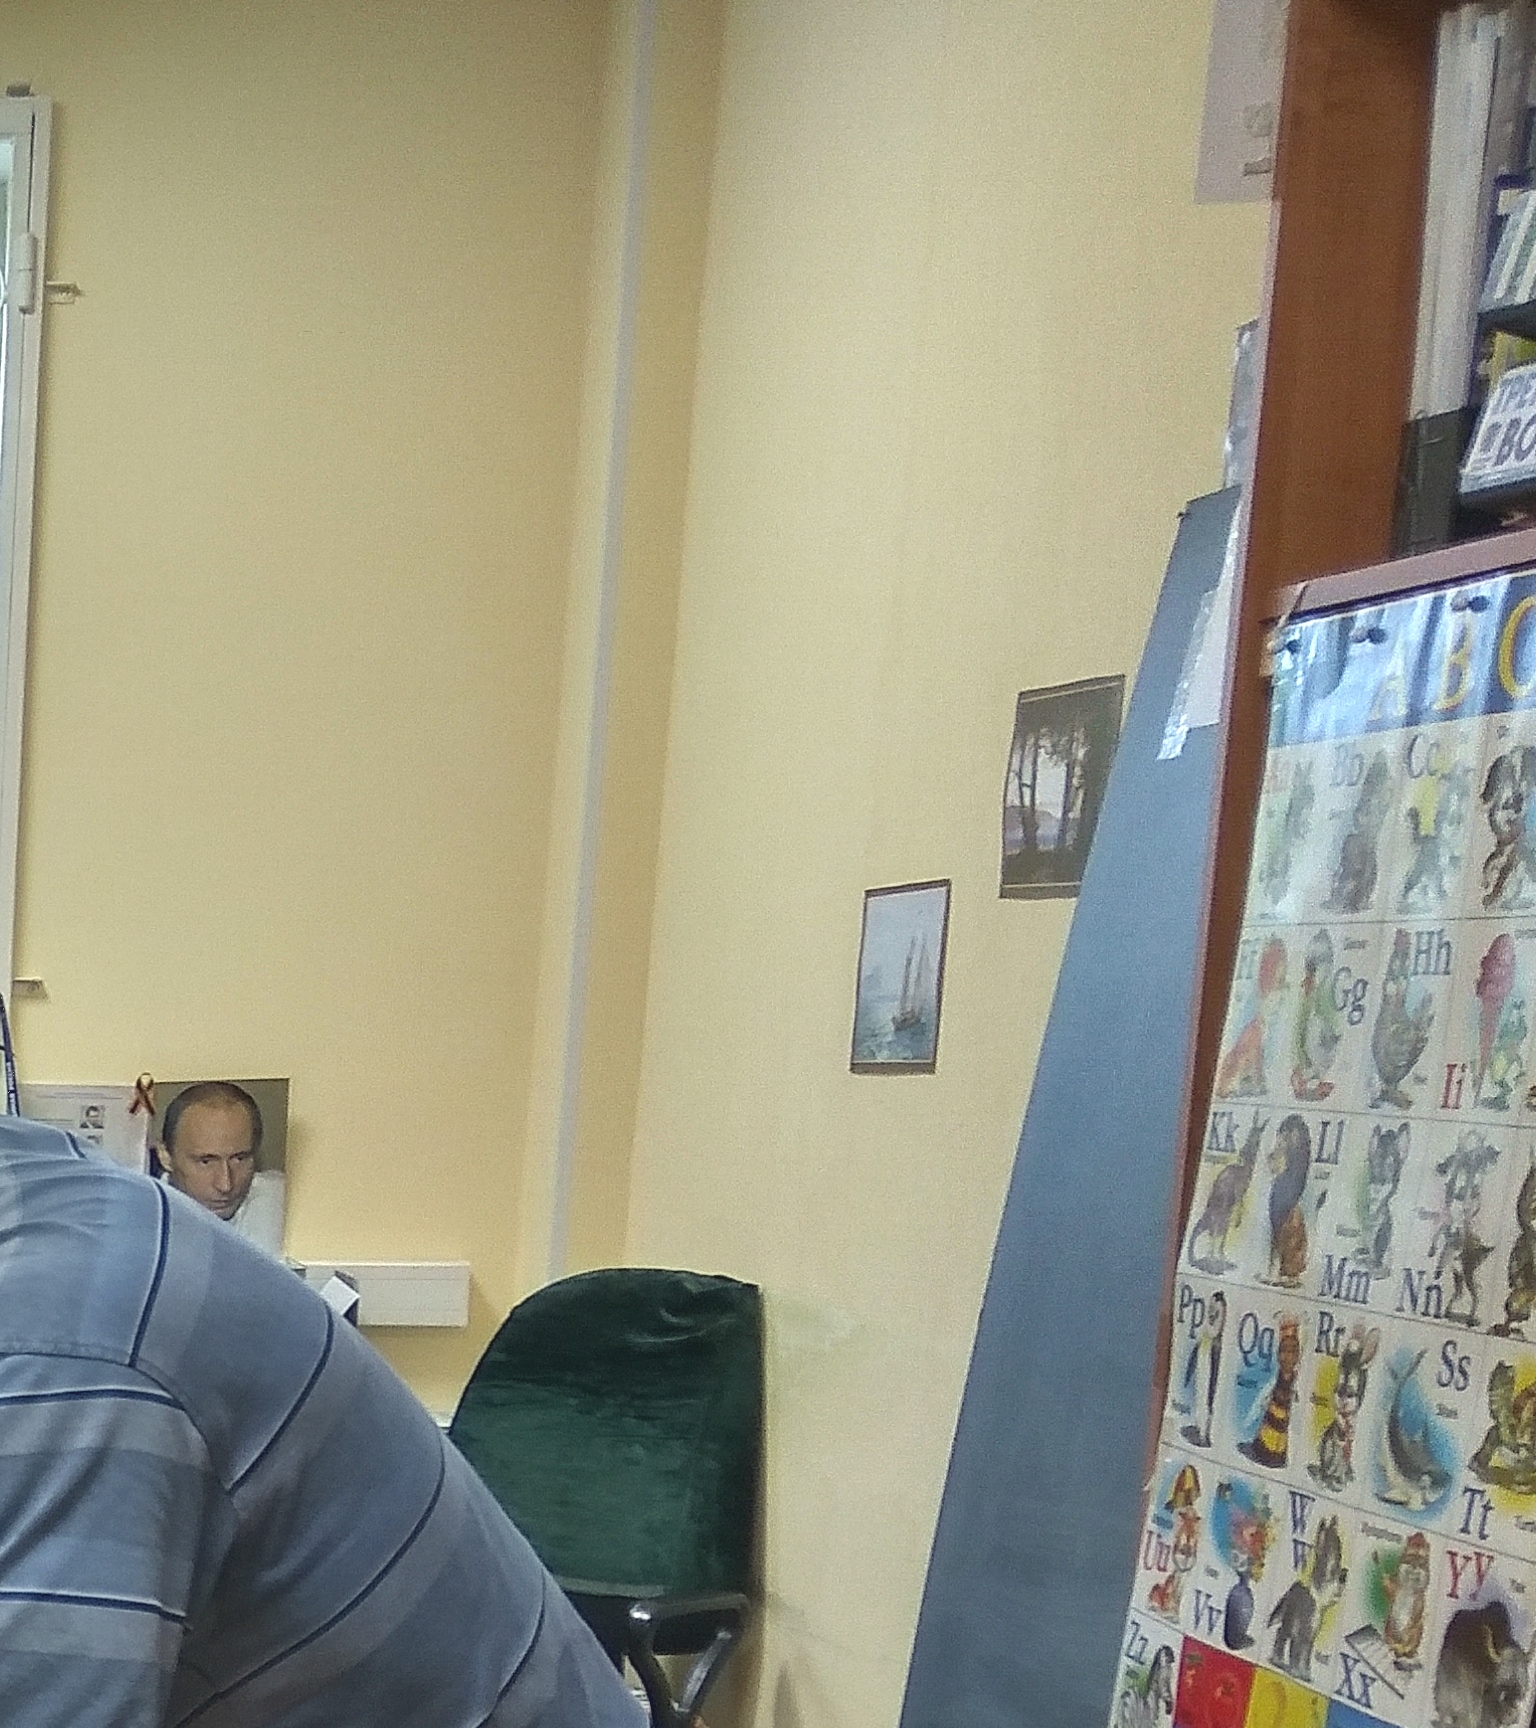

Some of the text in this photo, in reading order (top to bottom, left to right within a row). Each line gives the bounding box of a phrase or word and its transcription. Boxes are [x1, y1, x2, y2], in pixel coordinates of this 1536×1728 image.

[1413, 928, 1452, 976] Hh
[1332, 966, 1369, 1026] Gg
[1206, 1111, 1240, 1153] Kk
[1317, 1254, 1371, 1305] Mm
[1395, 1267, 1444, 1319] Nn
[1177, 1284, 1206, 1340] Pp
[1314, 1310, 1347, 1358] Rr
[1237, 1312, 1276, 1375] Qq
[1437, 1339, 1472, 1391] Ss
[1460, 1486, 1495, 1541] Tt
[1143, 1529, 1173, 1573] Uu
[1446, 1550, 1495, 1601] Yy
[1193, 1588, 1223, 1637] Vv
[1124, 1619, 1150, 1666] Zz
[1334, 1651, 1378, 1709] Xx
